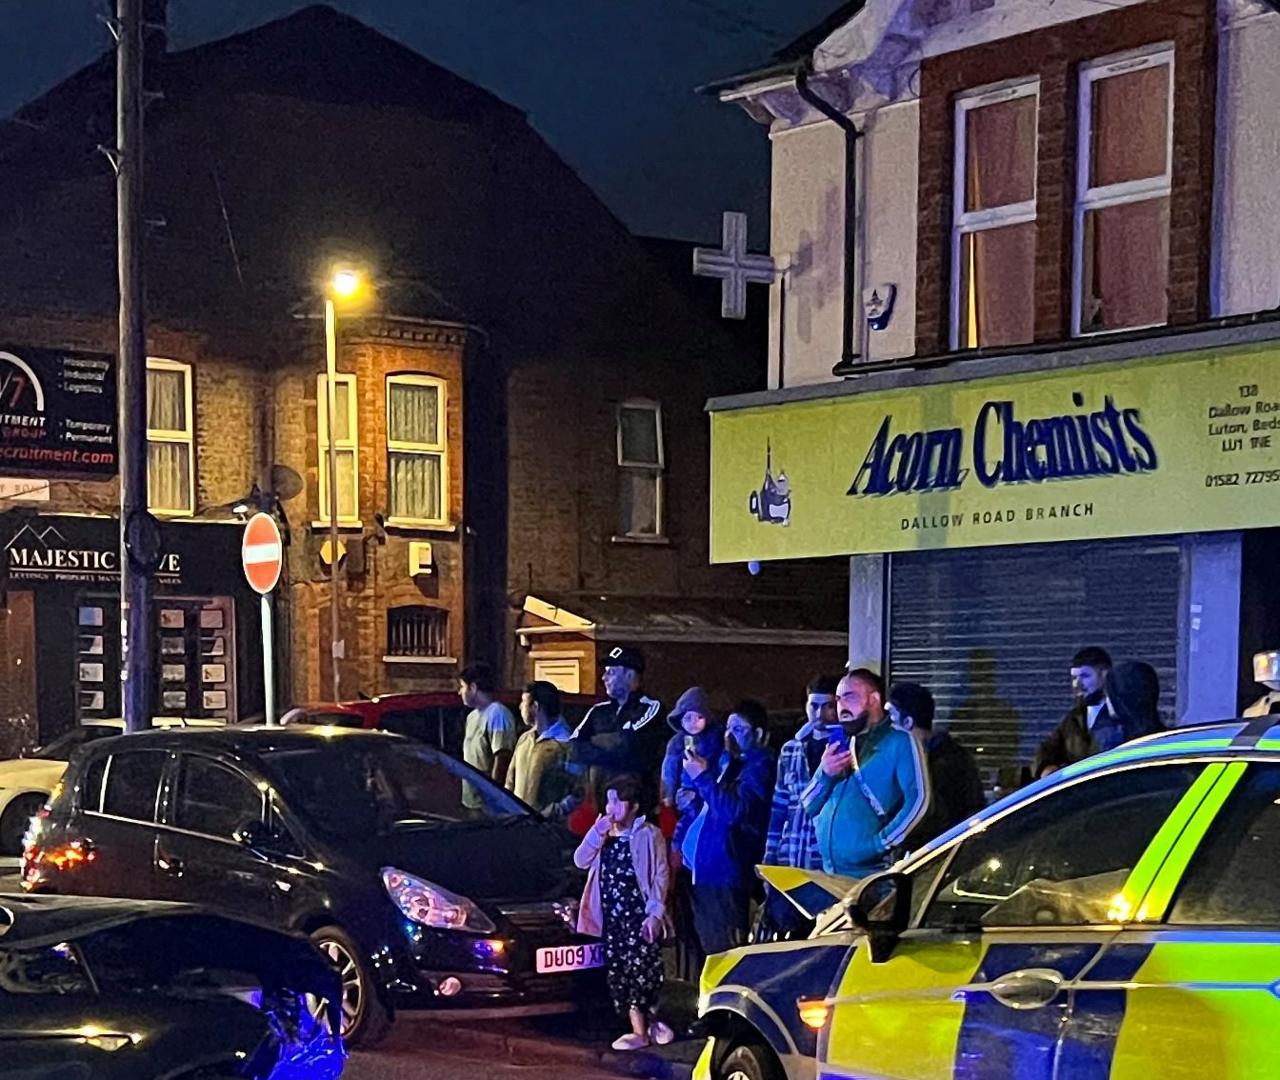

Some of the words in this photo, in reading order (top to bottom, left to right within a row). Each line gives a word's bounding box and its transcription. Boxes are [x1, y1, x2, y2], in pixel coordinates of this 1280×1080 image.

[1209, 404, 1251, 419] Dallow
[65, 431, 113, 444] Permanent
[1209, 423, 1248, 436] Luton,
[846, 414, 963, 496] Acorn
[973, 391, 1158, 489] Chemists
[901, 513, 964, 530] DALLOW
[972, 510, 1016, 526] ROAD
[1025, 502, 1095, 521] BRANCH
[9, 548, 116, 569] MAJESTIC
[544, 946, 585, 968] DU09
